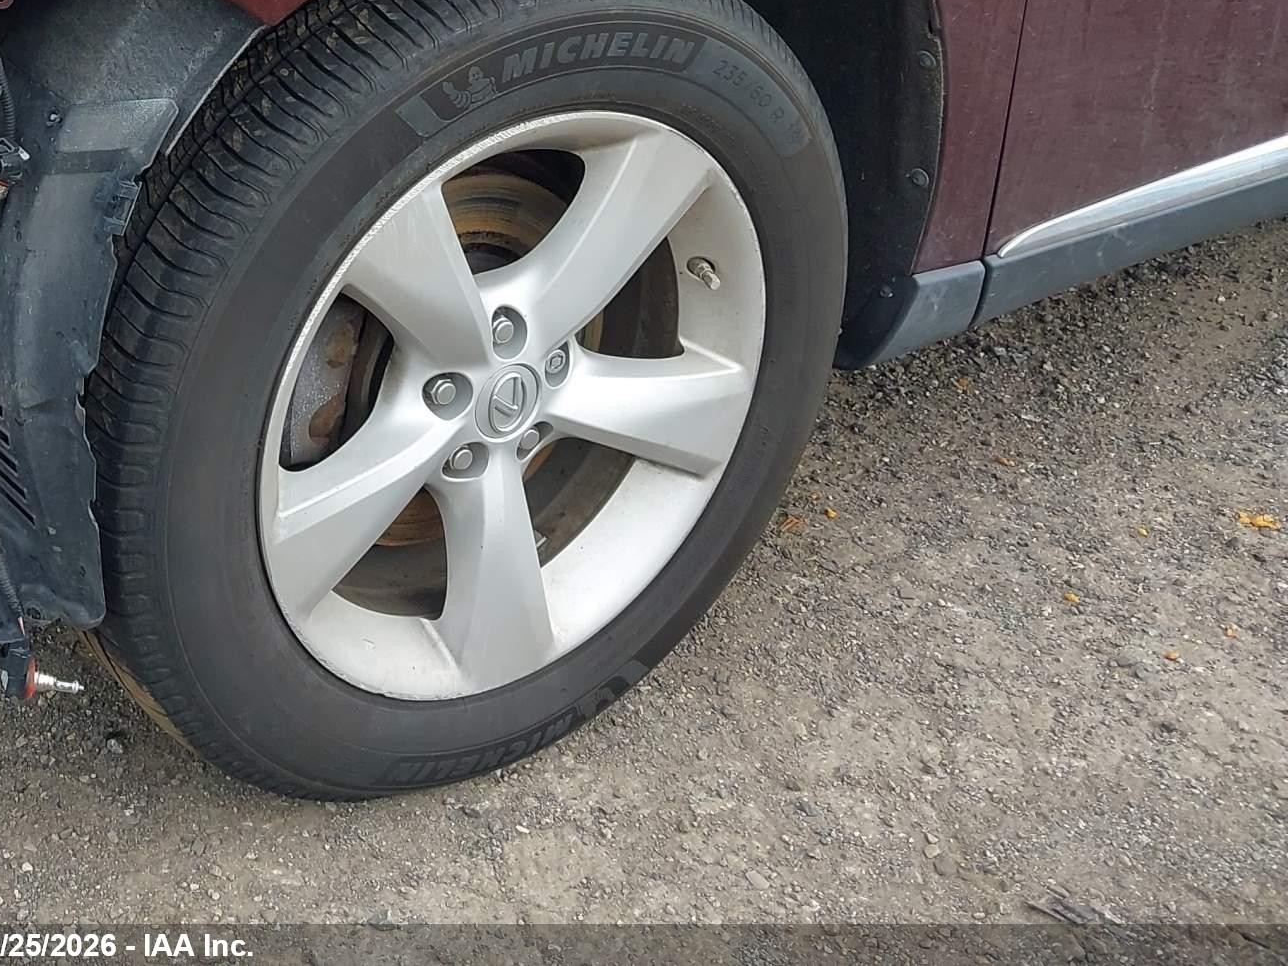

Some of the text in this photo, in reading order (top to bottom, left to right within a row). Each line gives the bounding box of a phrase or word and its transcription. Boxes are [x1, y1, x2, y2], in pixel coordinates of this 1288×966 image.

[500, 31, 695, 83] MICHELIN
[712, 59, 773, 108] 235/60
[770, 106, 785, 123] R
